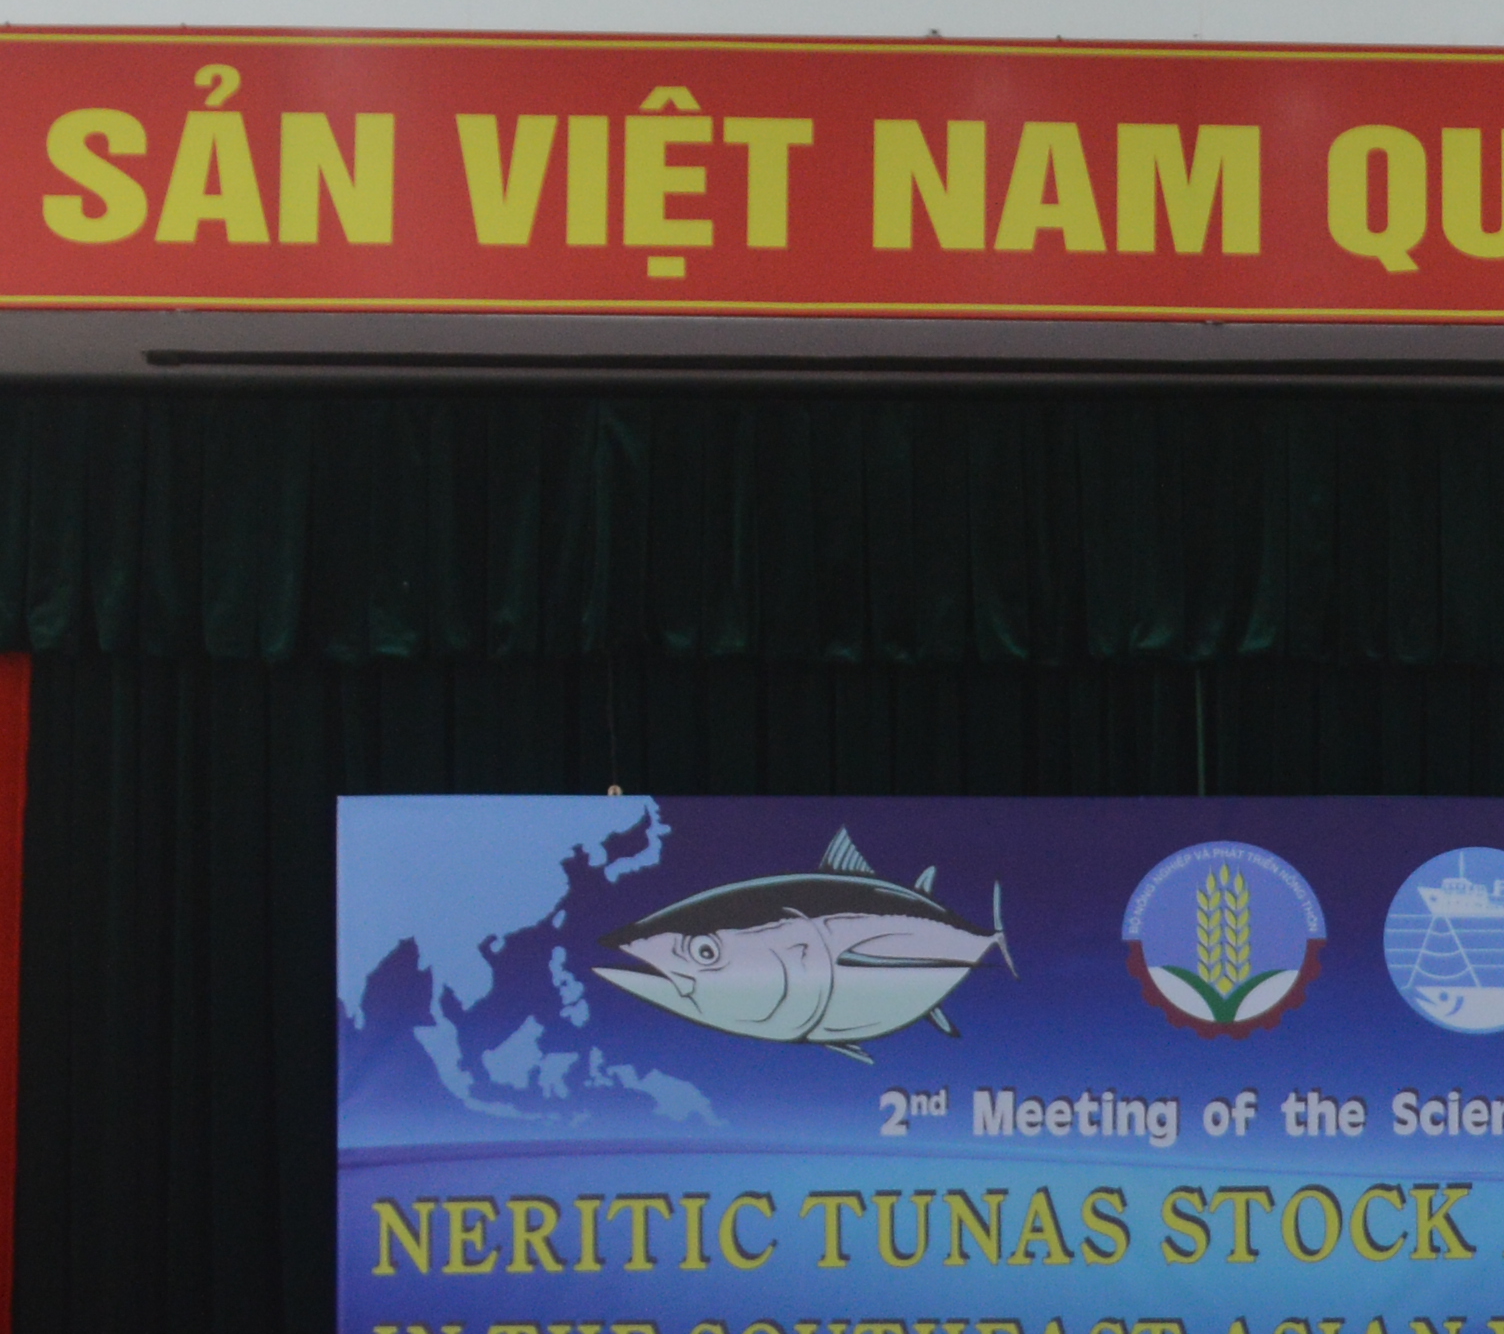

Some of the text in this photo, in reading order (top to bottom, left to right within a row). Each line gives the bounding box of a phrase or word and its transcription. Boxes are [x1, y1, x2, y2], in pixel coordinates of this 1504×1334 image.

[44, 65, 395, 244] SẢN
[458, 87, 813, 278] VIỆT
[873, 119, 1261, 254] NAM
[880, 1090, 946, 1137] 2nd
[973, 1090, 1177, 1145] Meeting
[1203, 1092, 1255, 1137] of
[1281, 1092, 1365, 1137] the
[374, 1195, 773, 1275] NERITIC
[802, 1191, 1128, 1268] TUNAS
[1163, 1187, 1472, 1263] STOCK
